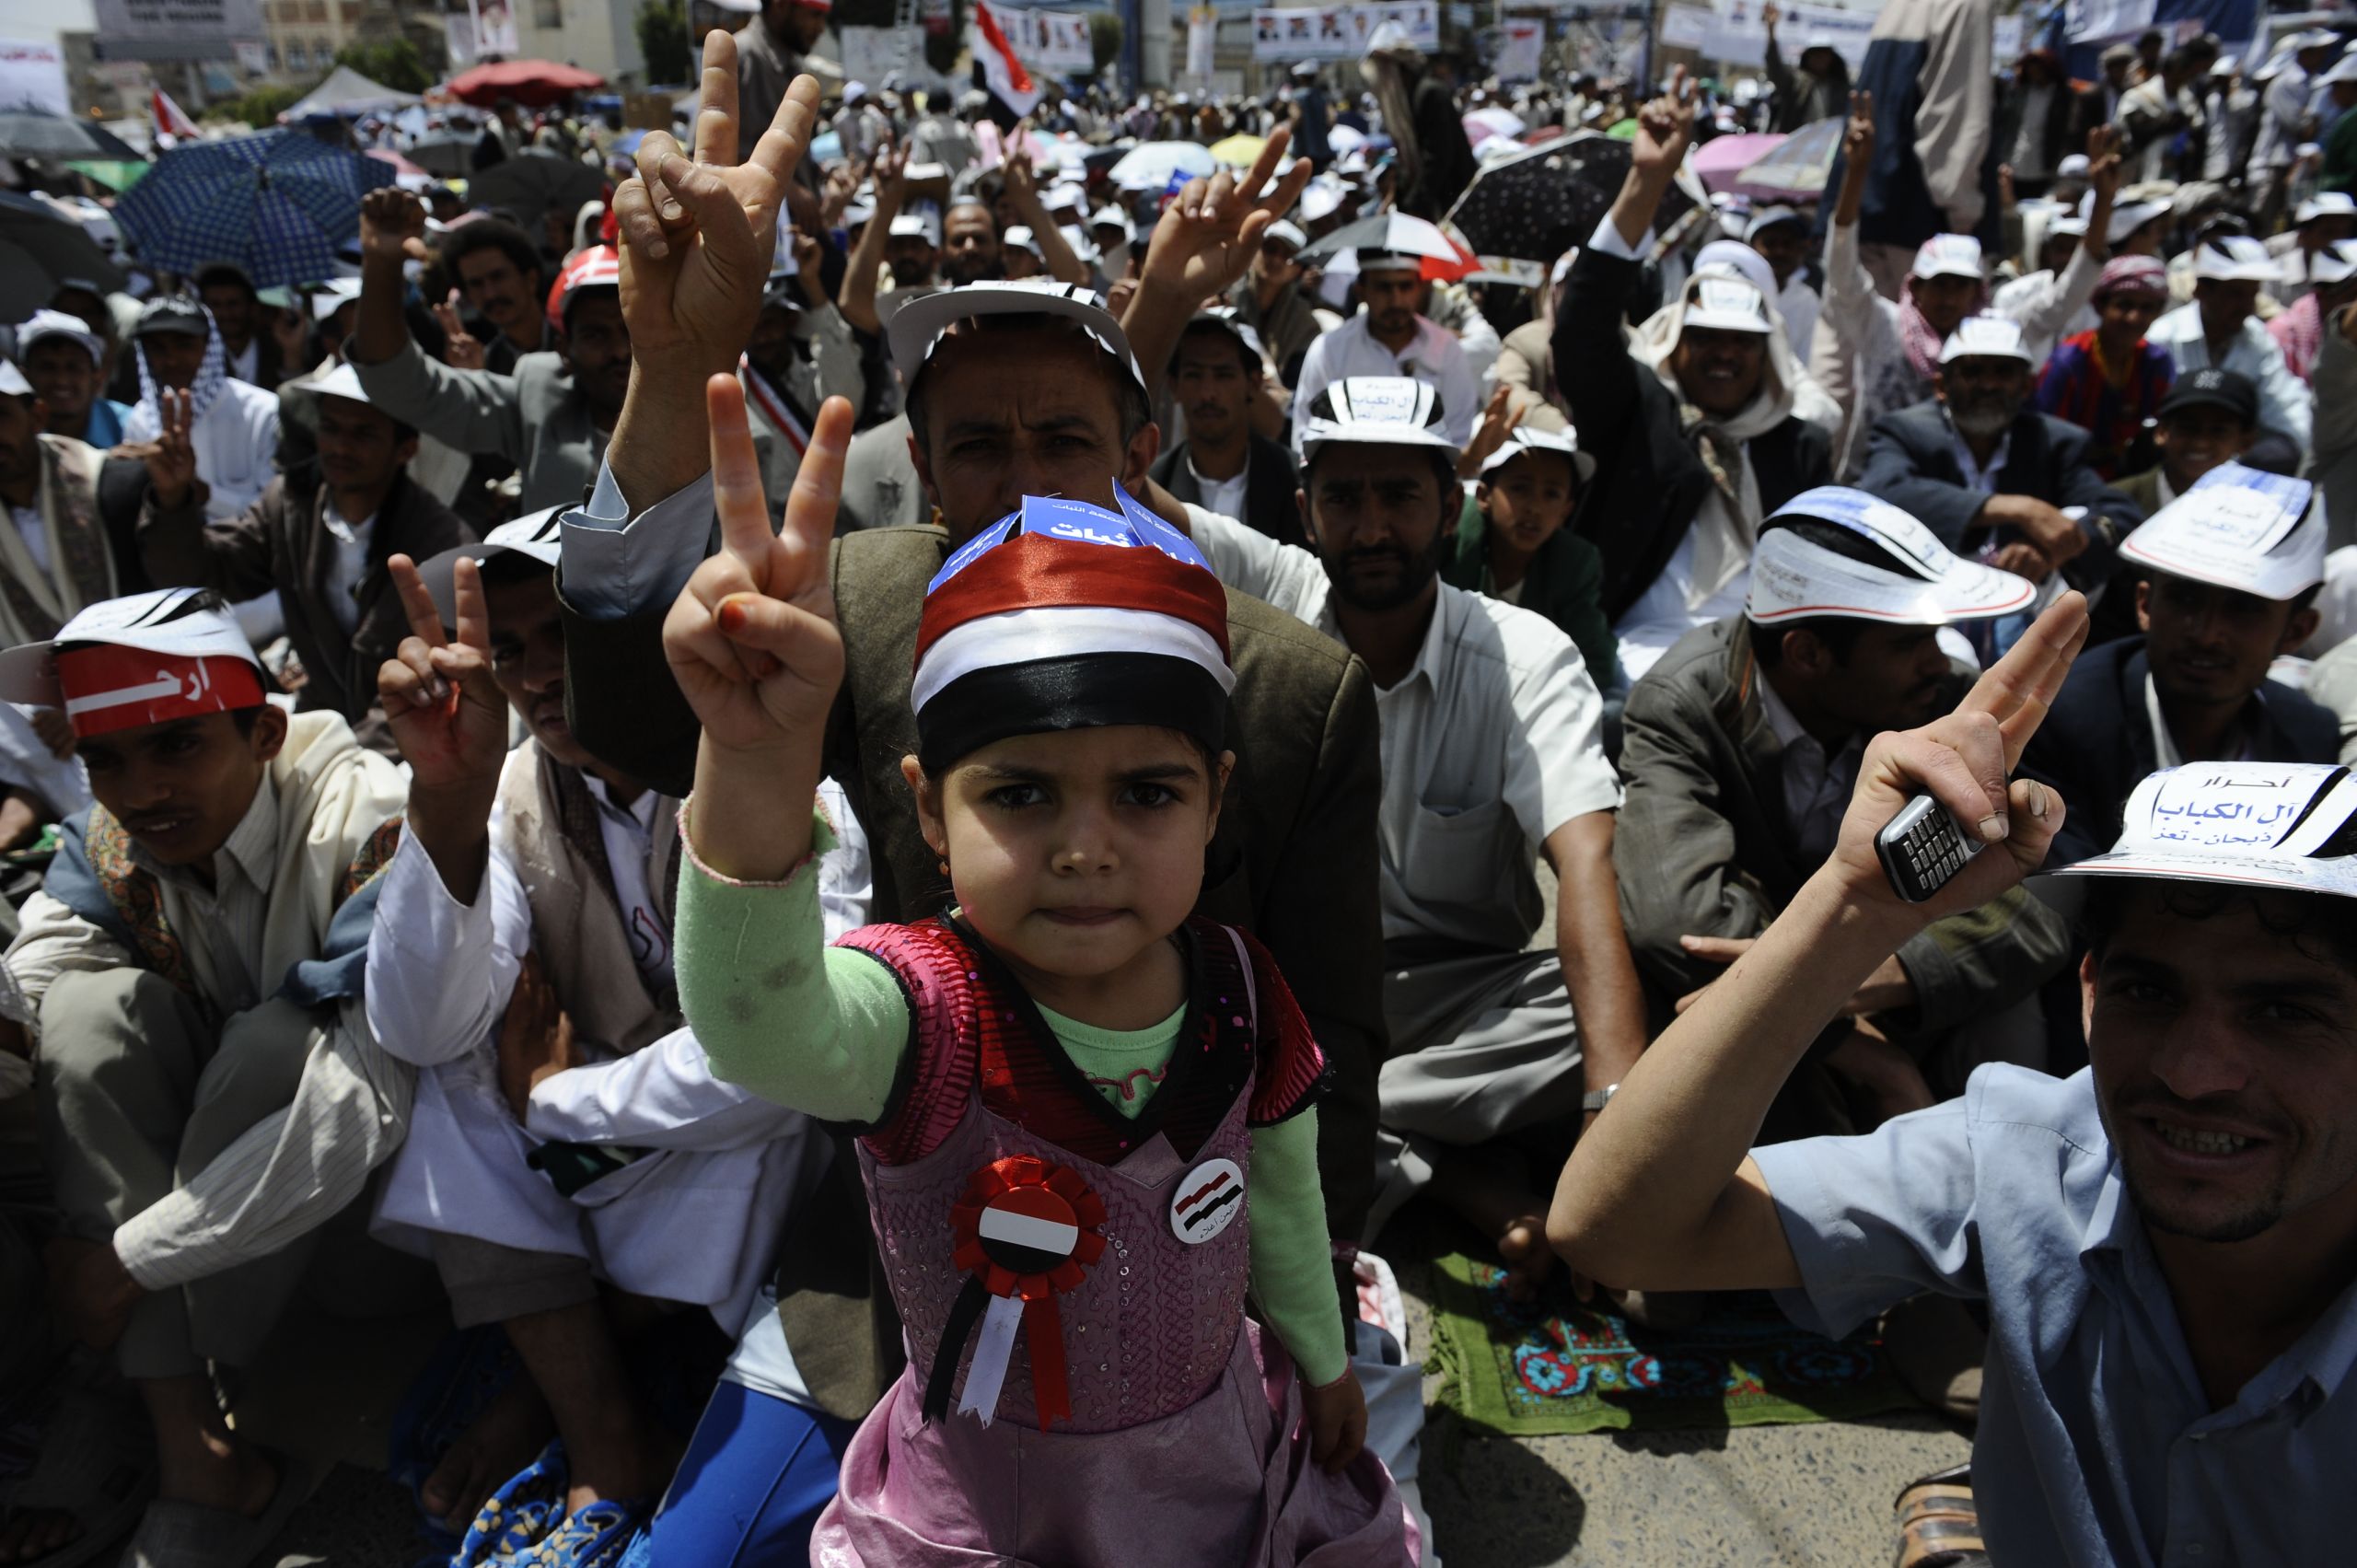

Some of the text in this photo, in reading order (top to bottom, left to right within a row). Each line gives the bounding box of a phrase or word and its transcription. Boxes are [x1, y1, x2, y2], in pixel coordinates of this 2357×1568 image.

[1050, 522, 1131, 548] ثبات
[2200, 776, 2294, 789] أحرار
[2157, 802, 2301, 826] آل الكباب
[2151, 828, 2189, 840] تعز
[2204, 832, 2272, 845] ذبحان
[1220, 1204, 1236, 1224] اليمن
